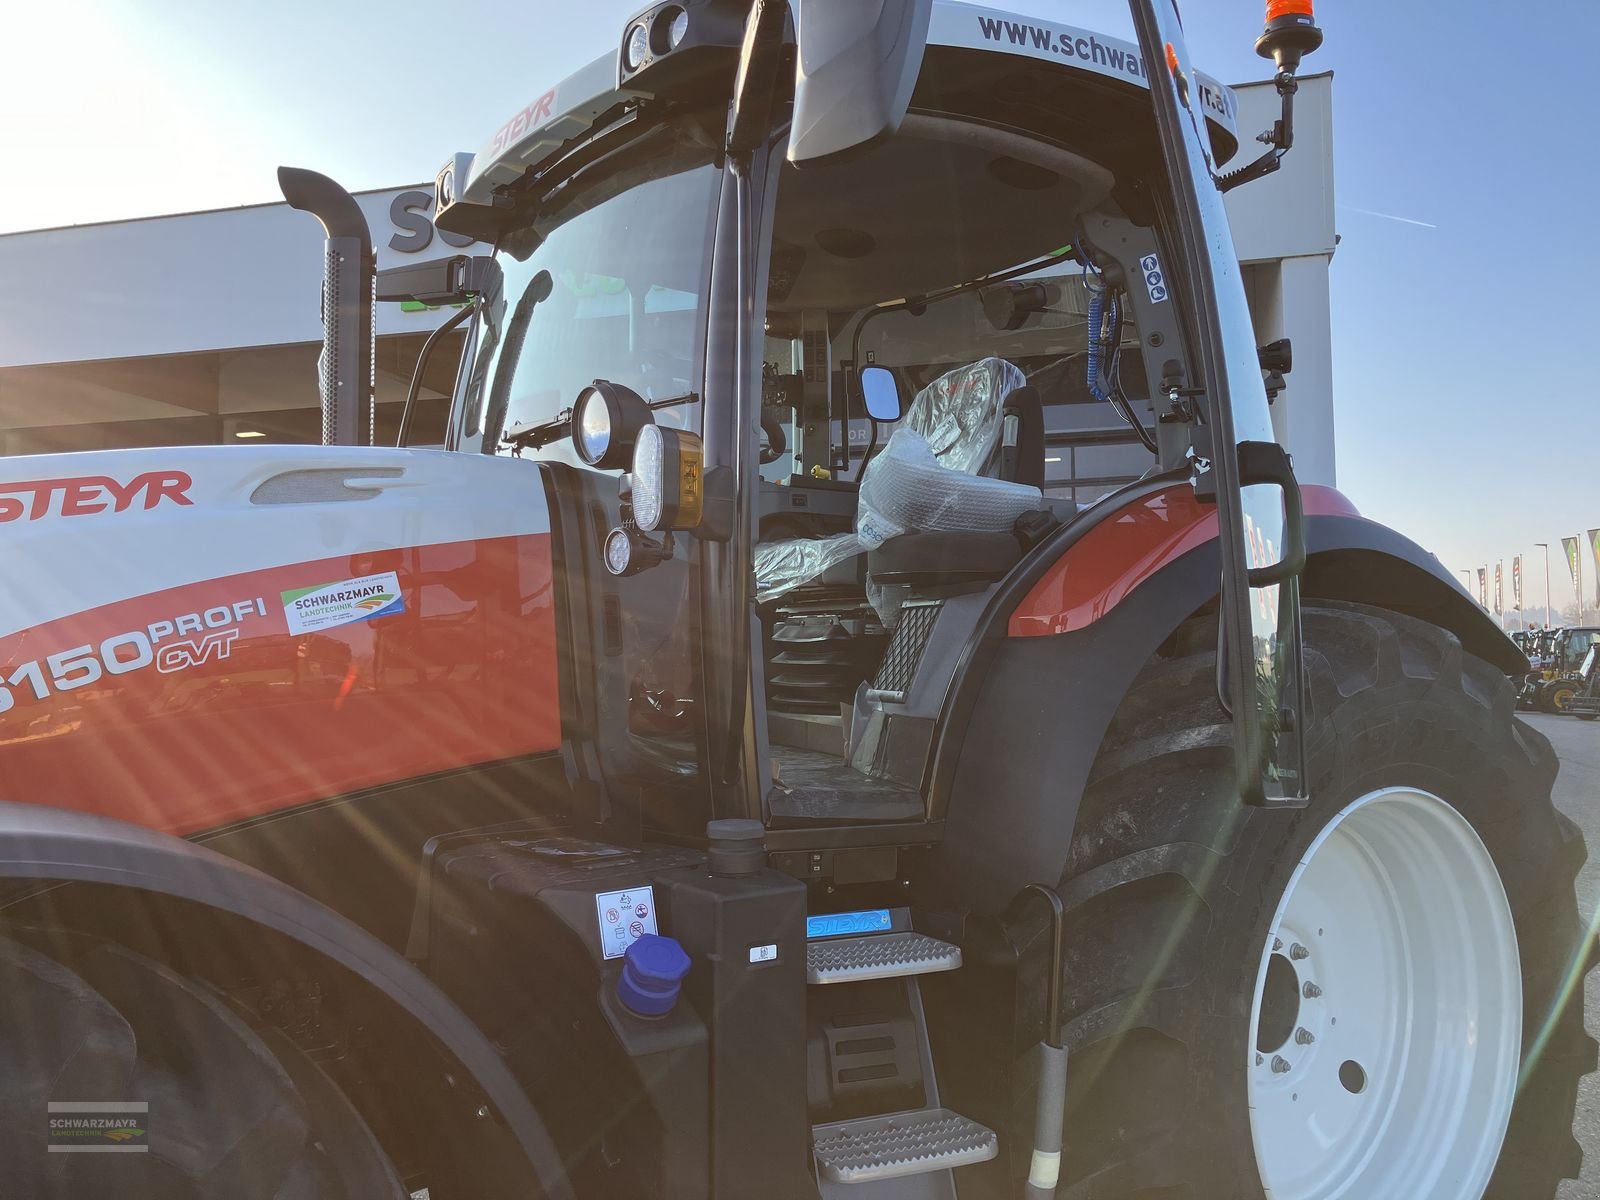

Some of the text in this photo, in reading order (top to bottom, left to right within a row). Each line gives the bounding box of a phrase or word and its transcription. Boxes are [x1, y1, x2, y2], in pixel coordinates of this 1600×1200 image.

[295, 585, 385, 610] SCHWARZMAYR
[300, 602, 353, 618] LANDTECHNIK
[147, 598, 267, 643] PROFI
[157, 628, 239, 673] CVT
[808, 912, 883, 935] STEYR
